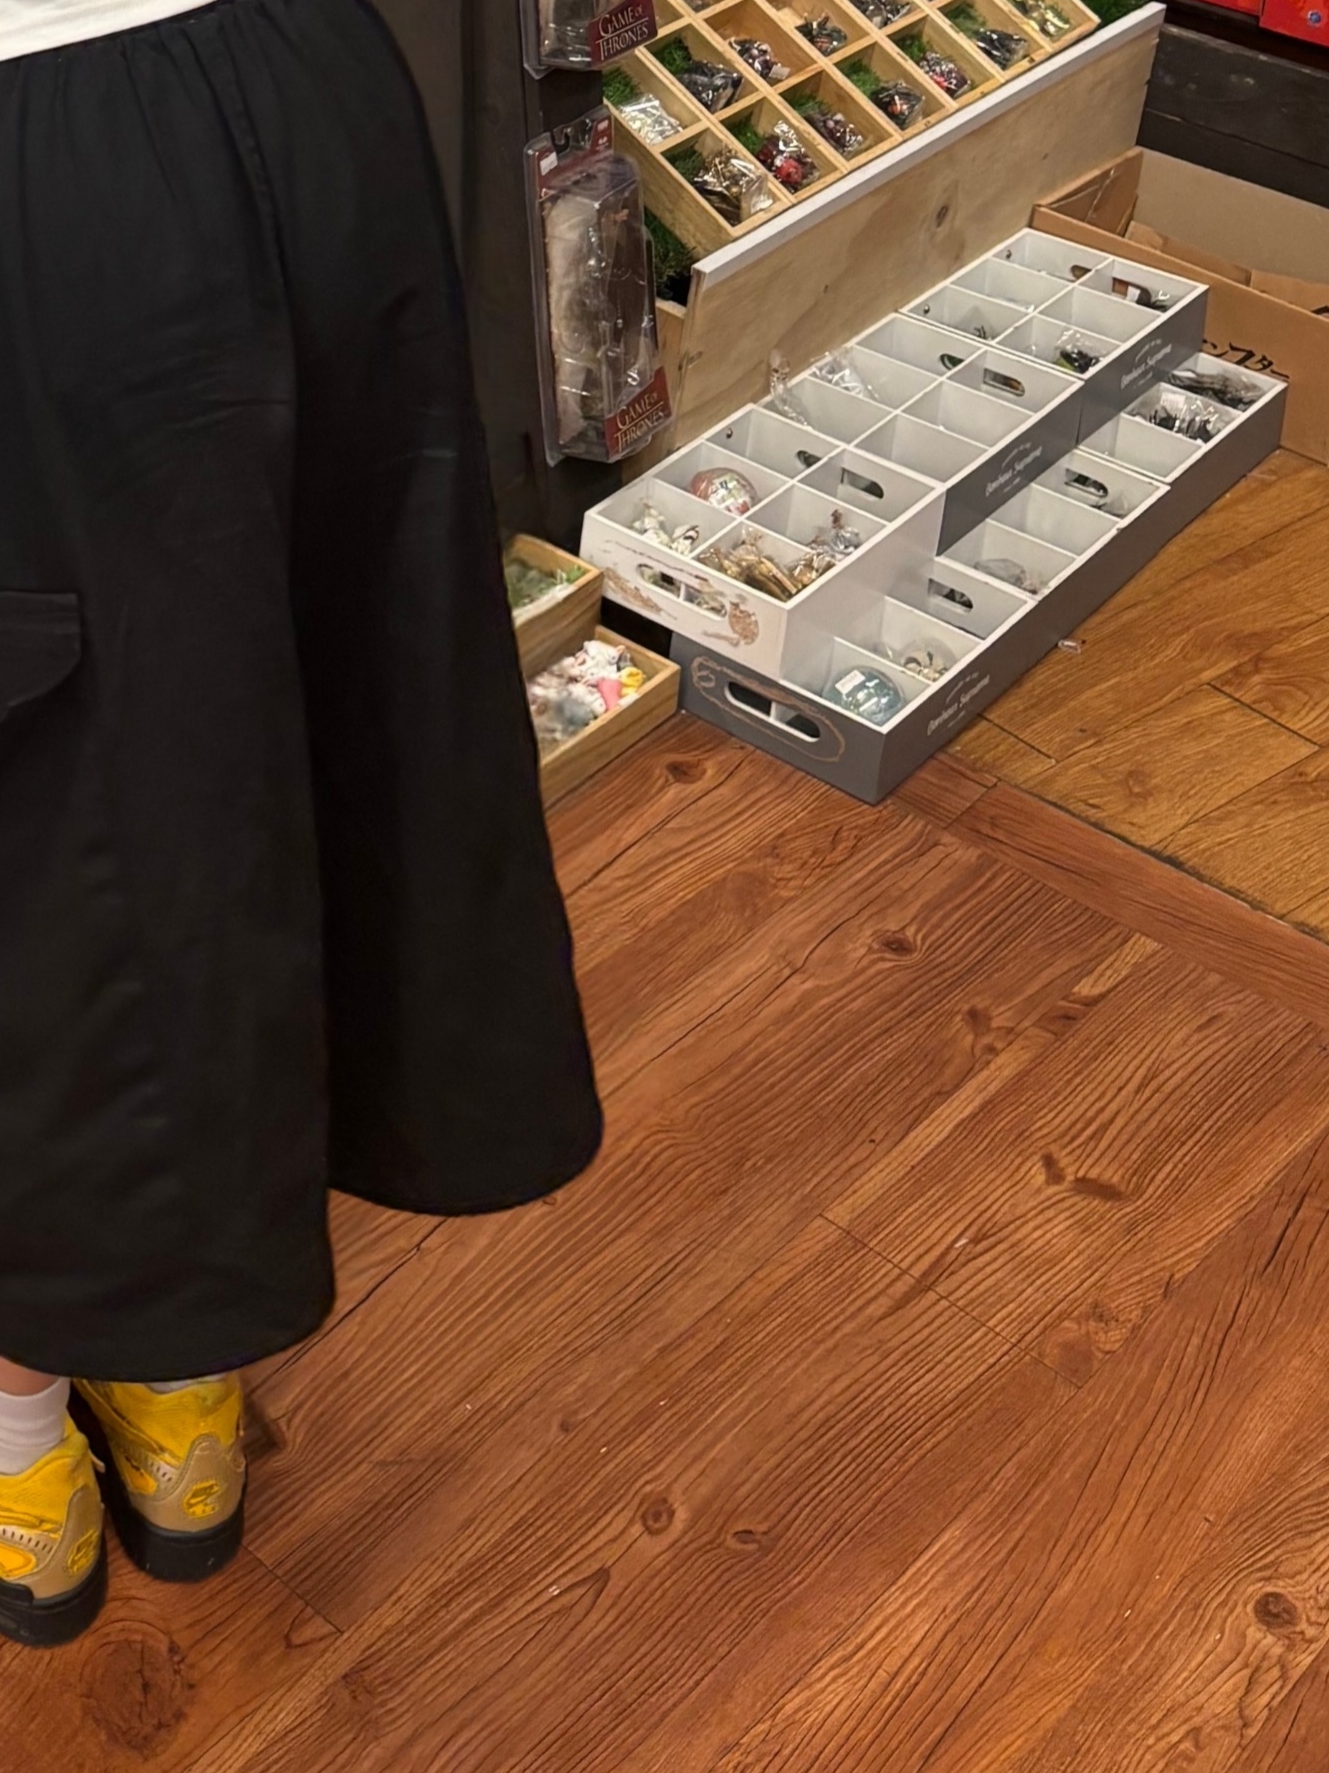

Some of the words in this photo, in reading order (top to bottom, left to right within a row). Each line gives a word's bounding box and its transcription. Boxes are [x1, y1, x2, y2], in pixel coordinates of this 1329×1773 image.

[599, 6, 635, 37] GAME
[596, 21, 649, 61] THRONES
[617, 393, 650, 429] GAME
